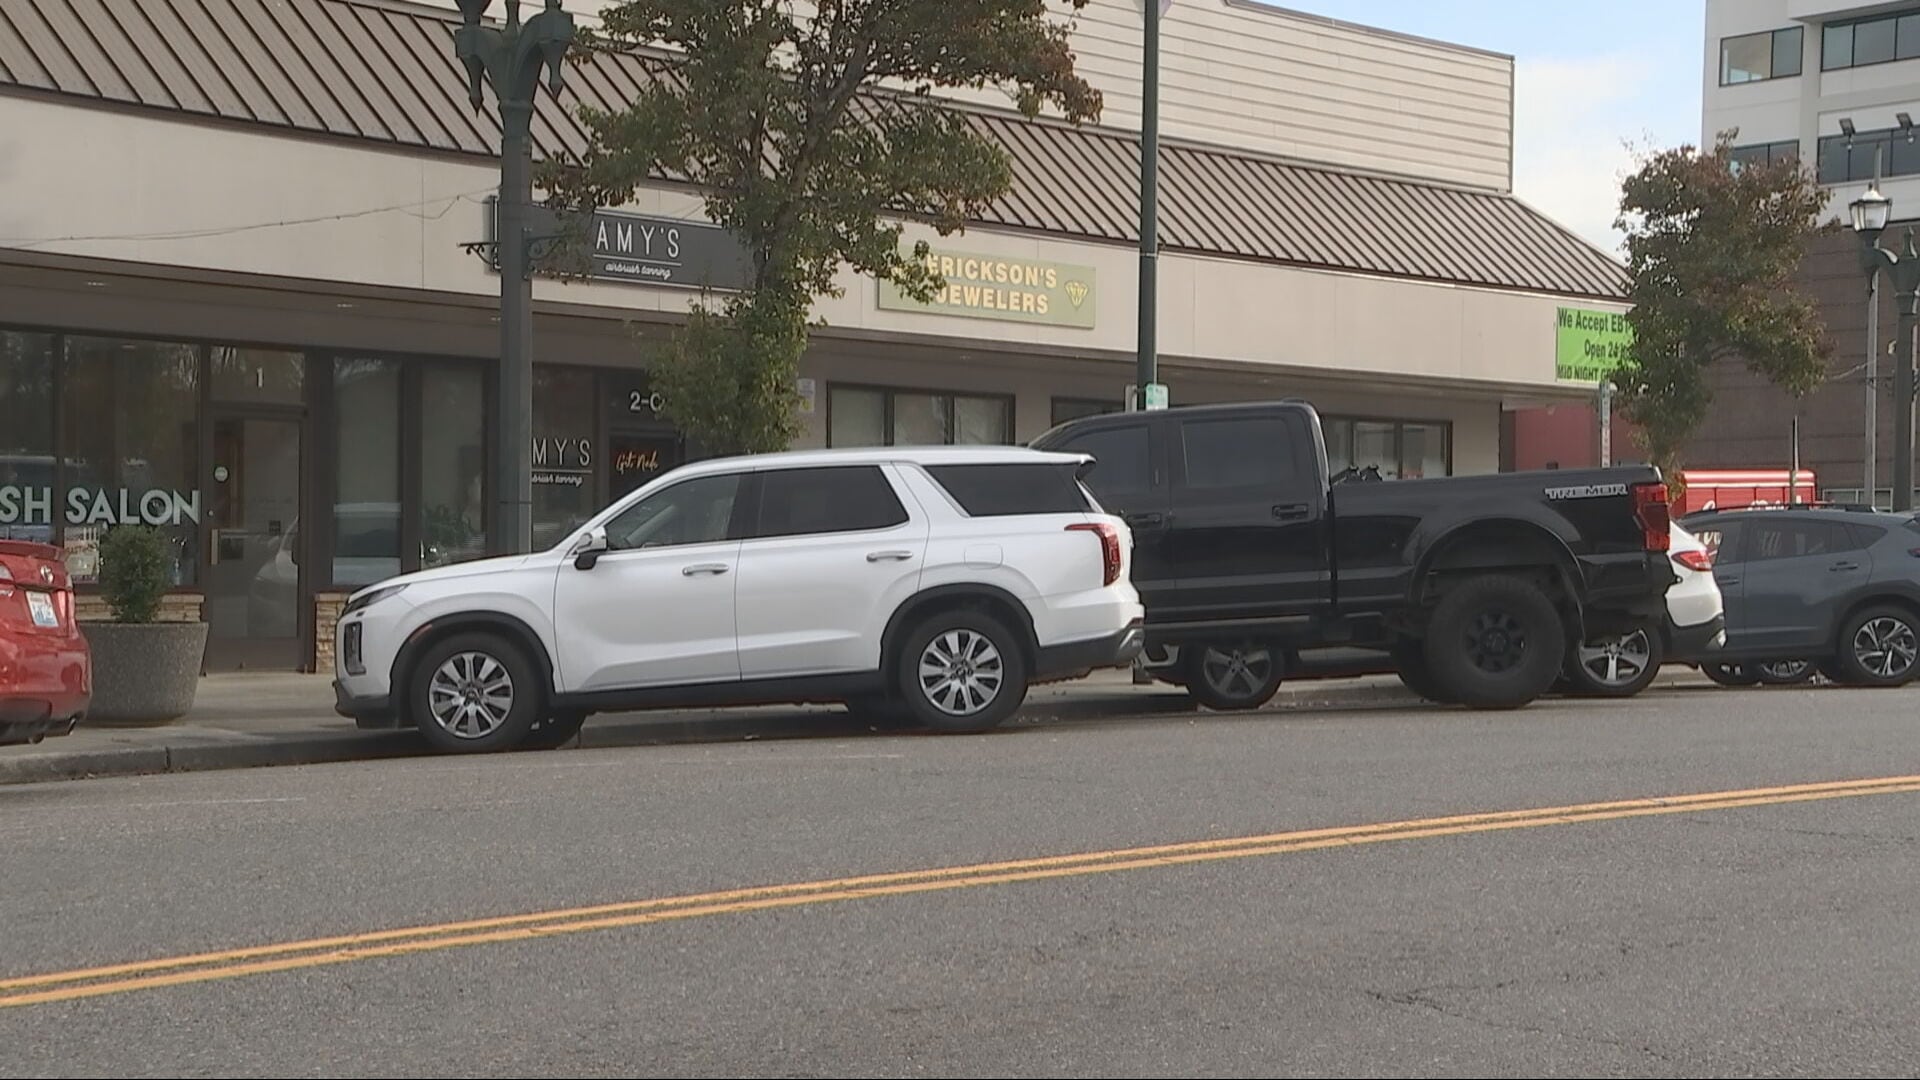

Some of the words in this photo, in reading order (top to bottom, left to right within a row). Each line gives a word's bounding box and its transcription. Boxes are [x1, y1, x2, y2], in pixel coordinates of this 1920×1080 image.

[596, 220, 680, 258] AMY'S
[605, 262, 640, 274] airbrush
[641, 265, 671, 280] tanning
[926, 253, 1057, 288] ERICKSON'S
[936, 284, 1049, 314] JEWELERS
[1557, 307, 1573, 329] We
[1575, 309, 1609, 336] Accept
[1584, 338, 1606, 361] Open
[1573, 365, 1599, 381] NIGHT
[532, 437, 590, 466] MY'S
[531, 474, 554, 484] brush
[1544, 483, 1628, 500] TREMOR
[65, 486, 200, 525] SALON
